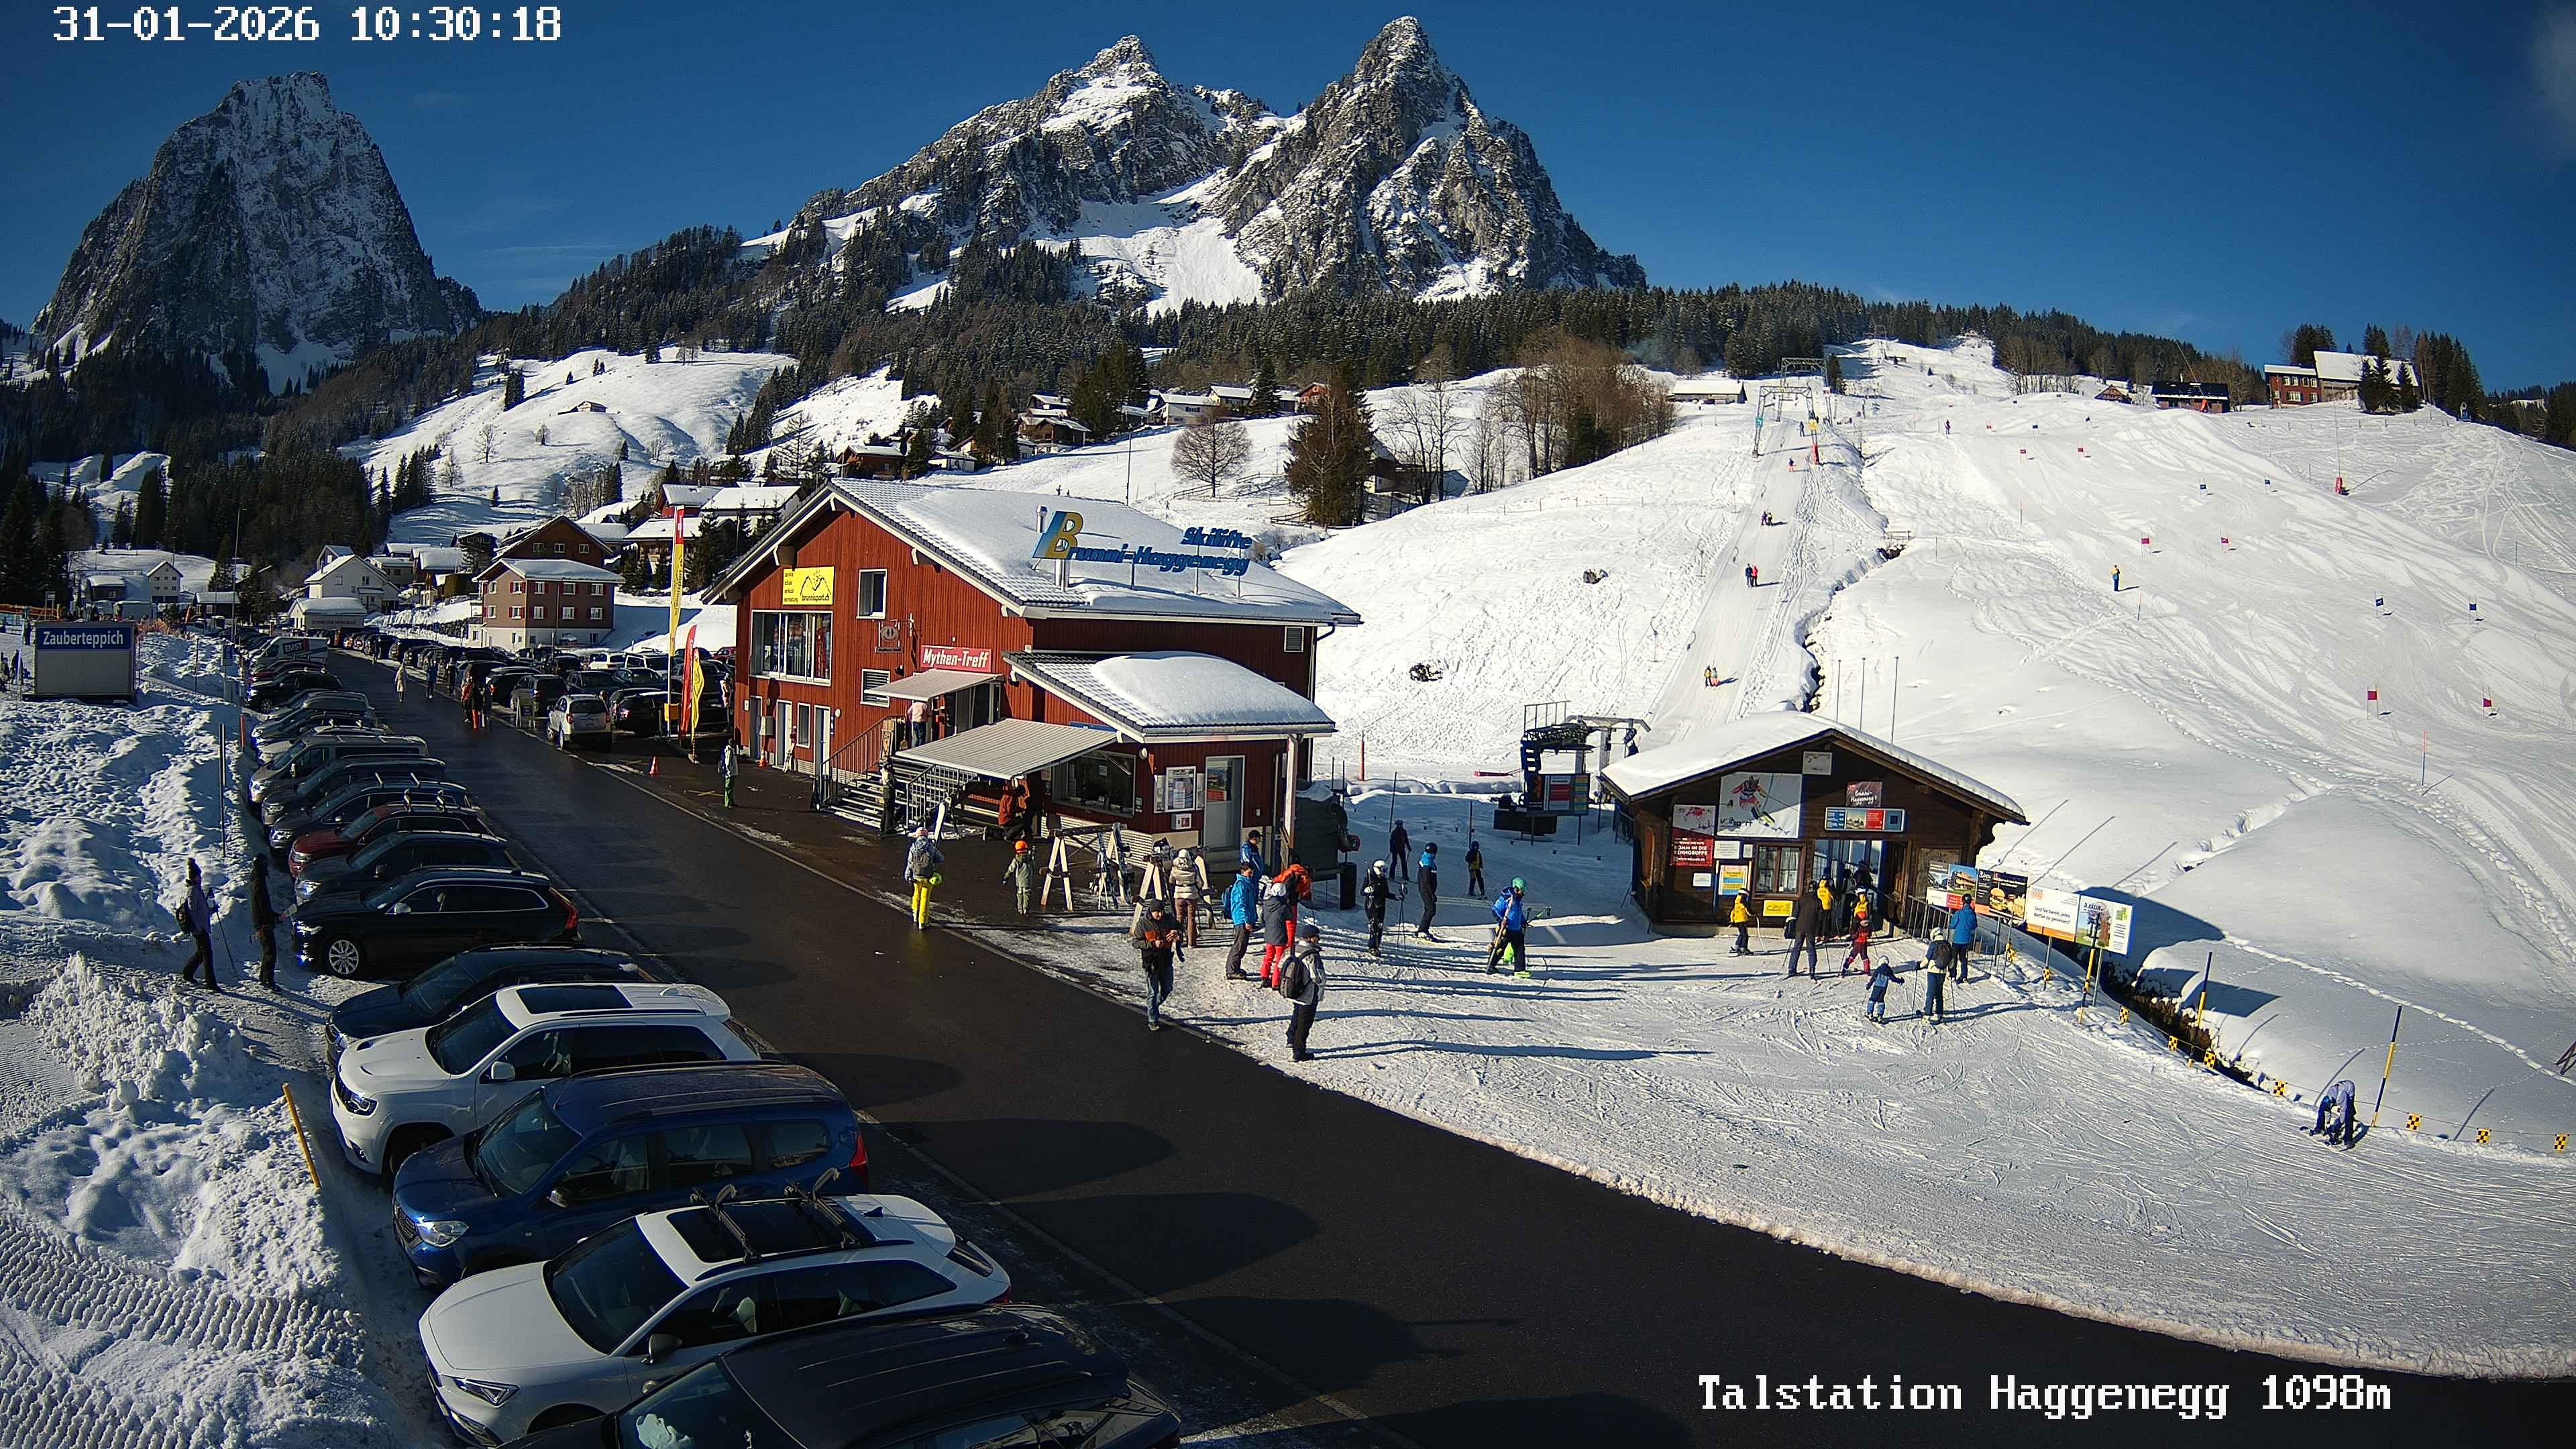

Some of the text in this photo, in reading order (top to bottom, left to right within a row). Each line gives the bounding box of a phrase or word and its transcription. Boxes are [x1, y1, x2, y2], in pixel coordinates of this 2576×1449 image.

[1032, 511, 1250, 576] Brunni-Haggenegg
[1181, 526, 1252, 549] Skilifte
[43, 631, 123, 648] Zauberteppich
[922, 647, 989, 668] Mythen-Treff
